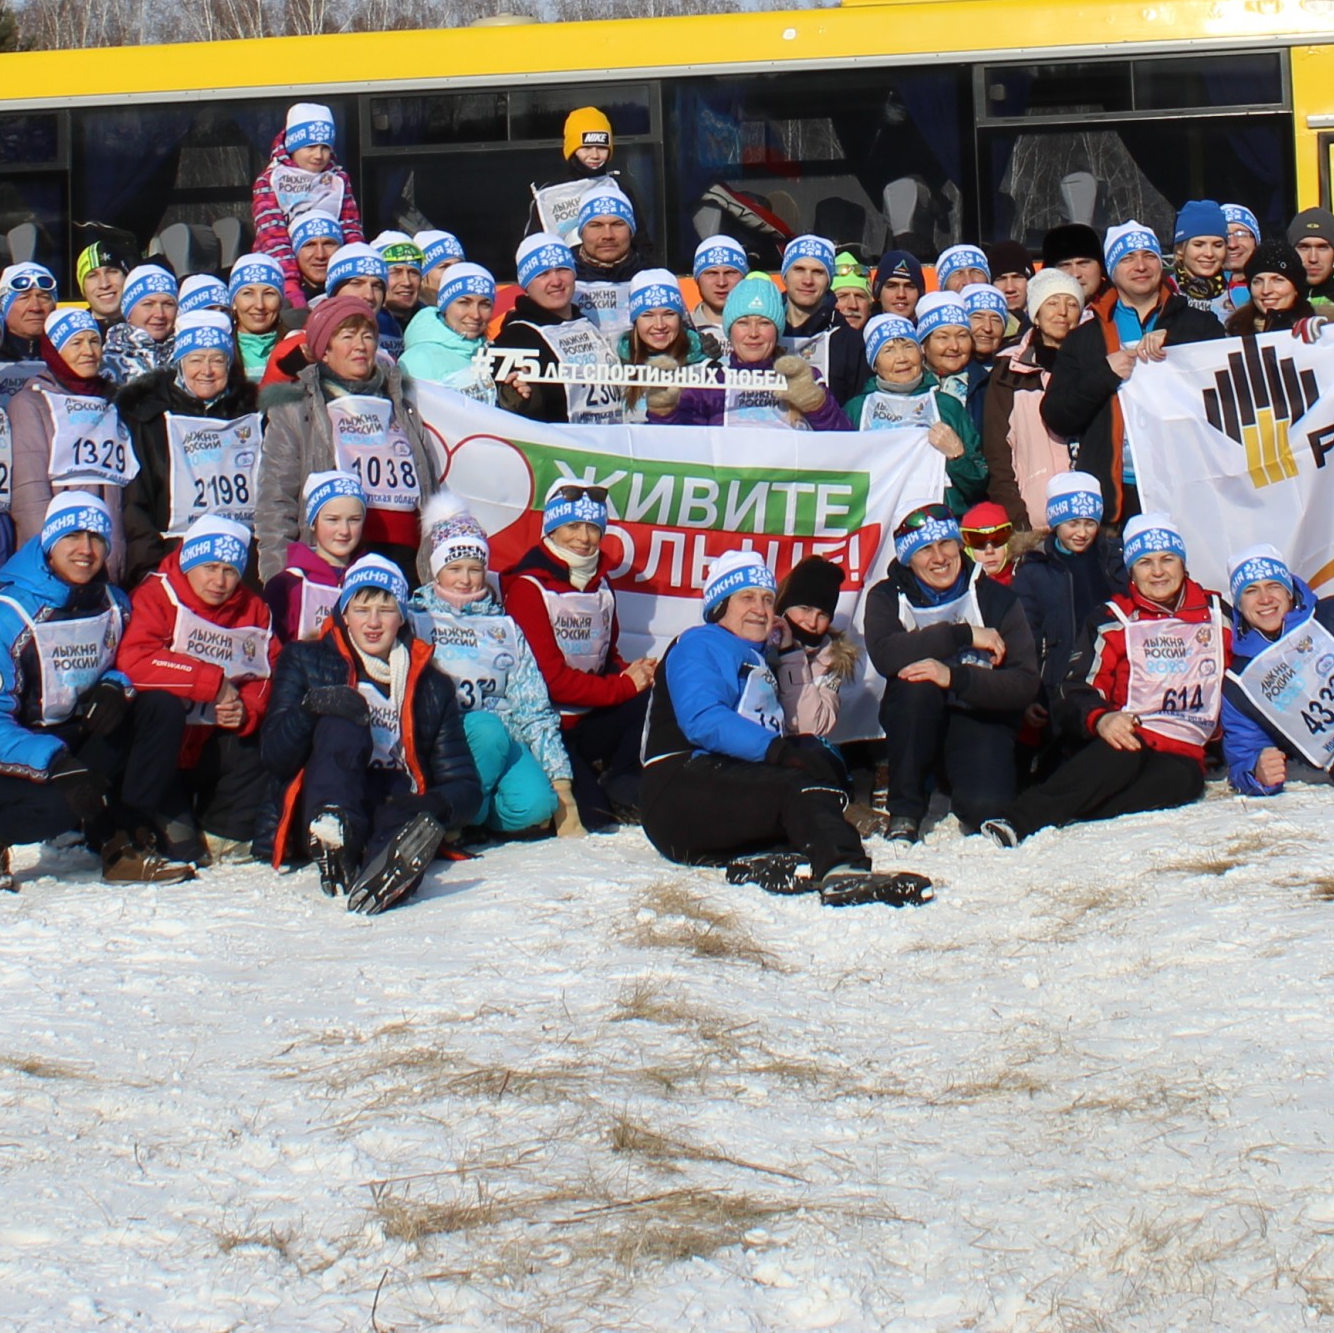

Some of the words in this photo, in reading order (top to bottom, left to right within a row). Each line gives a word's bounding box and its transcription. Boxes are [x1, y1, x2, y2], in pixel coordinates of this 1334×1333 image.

[584, 132, 608, 144] NIKE
[578, 290, 617, 301] ЛЫЖНЯ
[578, 299, 618, 311] РОССИИ
[559, 333, 590, 348] ЛЫЖНЯ
[563, 342, 595, 356] РОССИИ
[470, 346, 541, 383] #75
[544, 363, 582, 382] ЛЕТ
[586, 363, 719, 388] СПОРТИВНЫХ
[724, 367, 787, 389] ПОБЕД
[739, 398, 780, 408] РОССИИ
[338, 413, 380, 427] ЛЫЖНЯ
[339, 422, 384, 434] РОССИИ
[184, 440, 223, 454] РОССИИ
[72, 438, 127, 474] 1329
[352, 455, 418, 489] 1038
[193, 472, 250, 508] 2198
[553, 459, 853, 537] ЖИВИТЕ
[554, 616, 592, 629] ЛЫЖНЯ
[188, 629, 233, 648] ЛЫЖНЯ
[430, 626, 475, 638] ЛЫЖНЯ
[555, 626, 592, 640] РОССИИ
[431, 636, 478, 648] РОССИИ
[1142, 635, 1185, 649] ЛЫЖНЯ
[51, 643, 98, 658] ЛЫЖНЯ
[187, 641, 233, 660] РОССИИ
[1144, 646, 1187, 659] РОССИИ
[53, 655, 100, 671] РОССИИ
[151, 658, 192, 673] FORWARD
[1146, 659, 1189, 674] 2020
[1260, 662, 1291, 696] ЛЫЖНЯ
[1265, 669, 1297, 703] РОССИИ
[1161, 683, 1205, 713] 614
